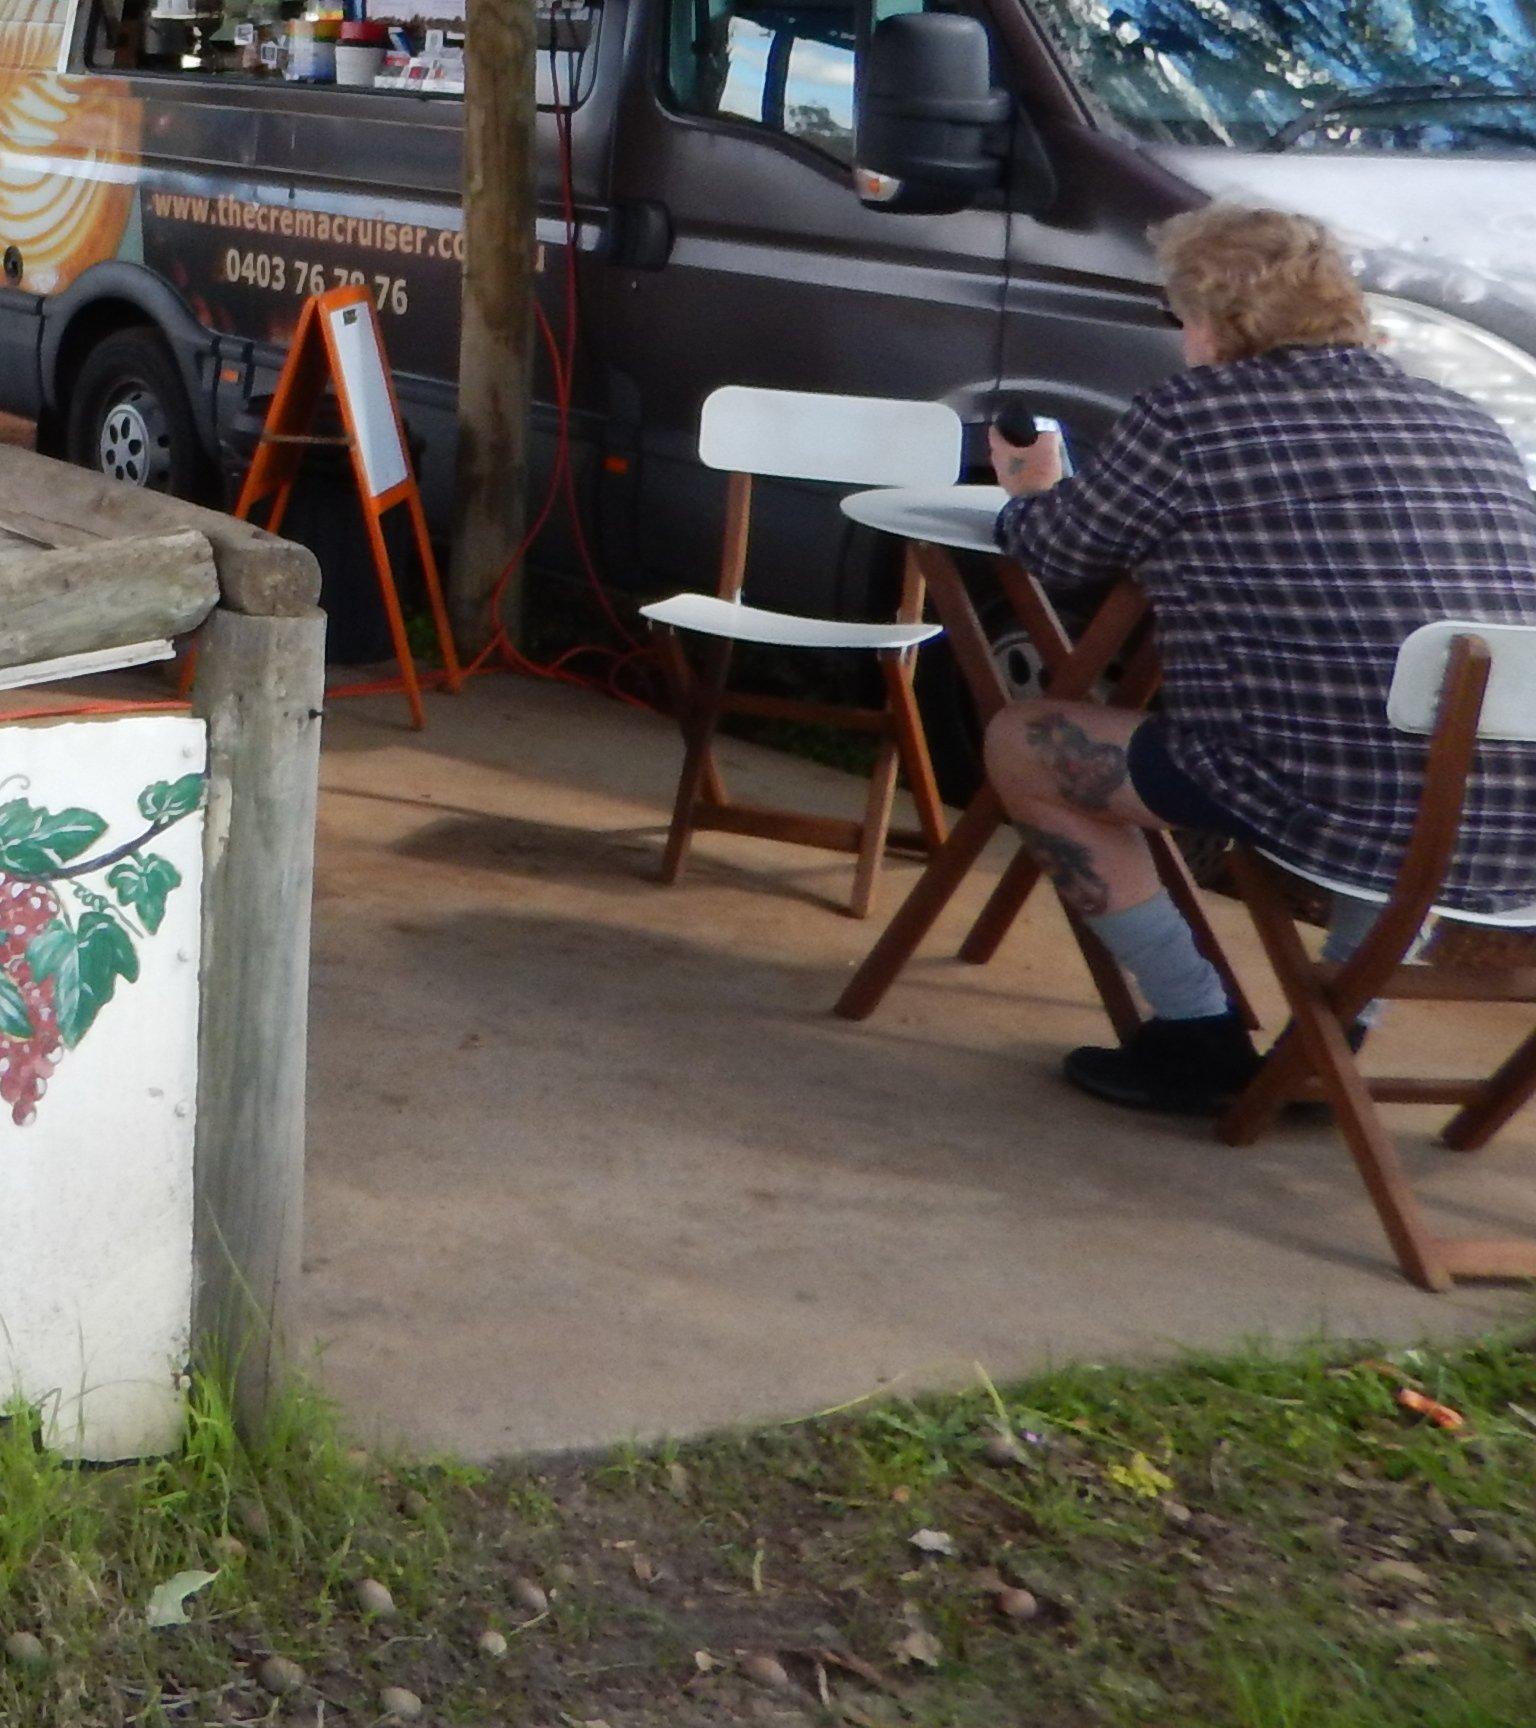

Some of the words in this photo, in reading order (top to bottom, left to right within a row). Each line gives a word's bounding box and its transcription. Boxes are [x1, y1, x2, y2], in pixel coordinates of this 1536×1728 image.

[226, 248, 286, 291] 0403
[294, 260, 325, 296] 76
[374, 275, 408, 315] 76
